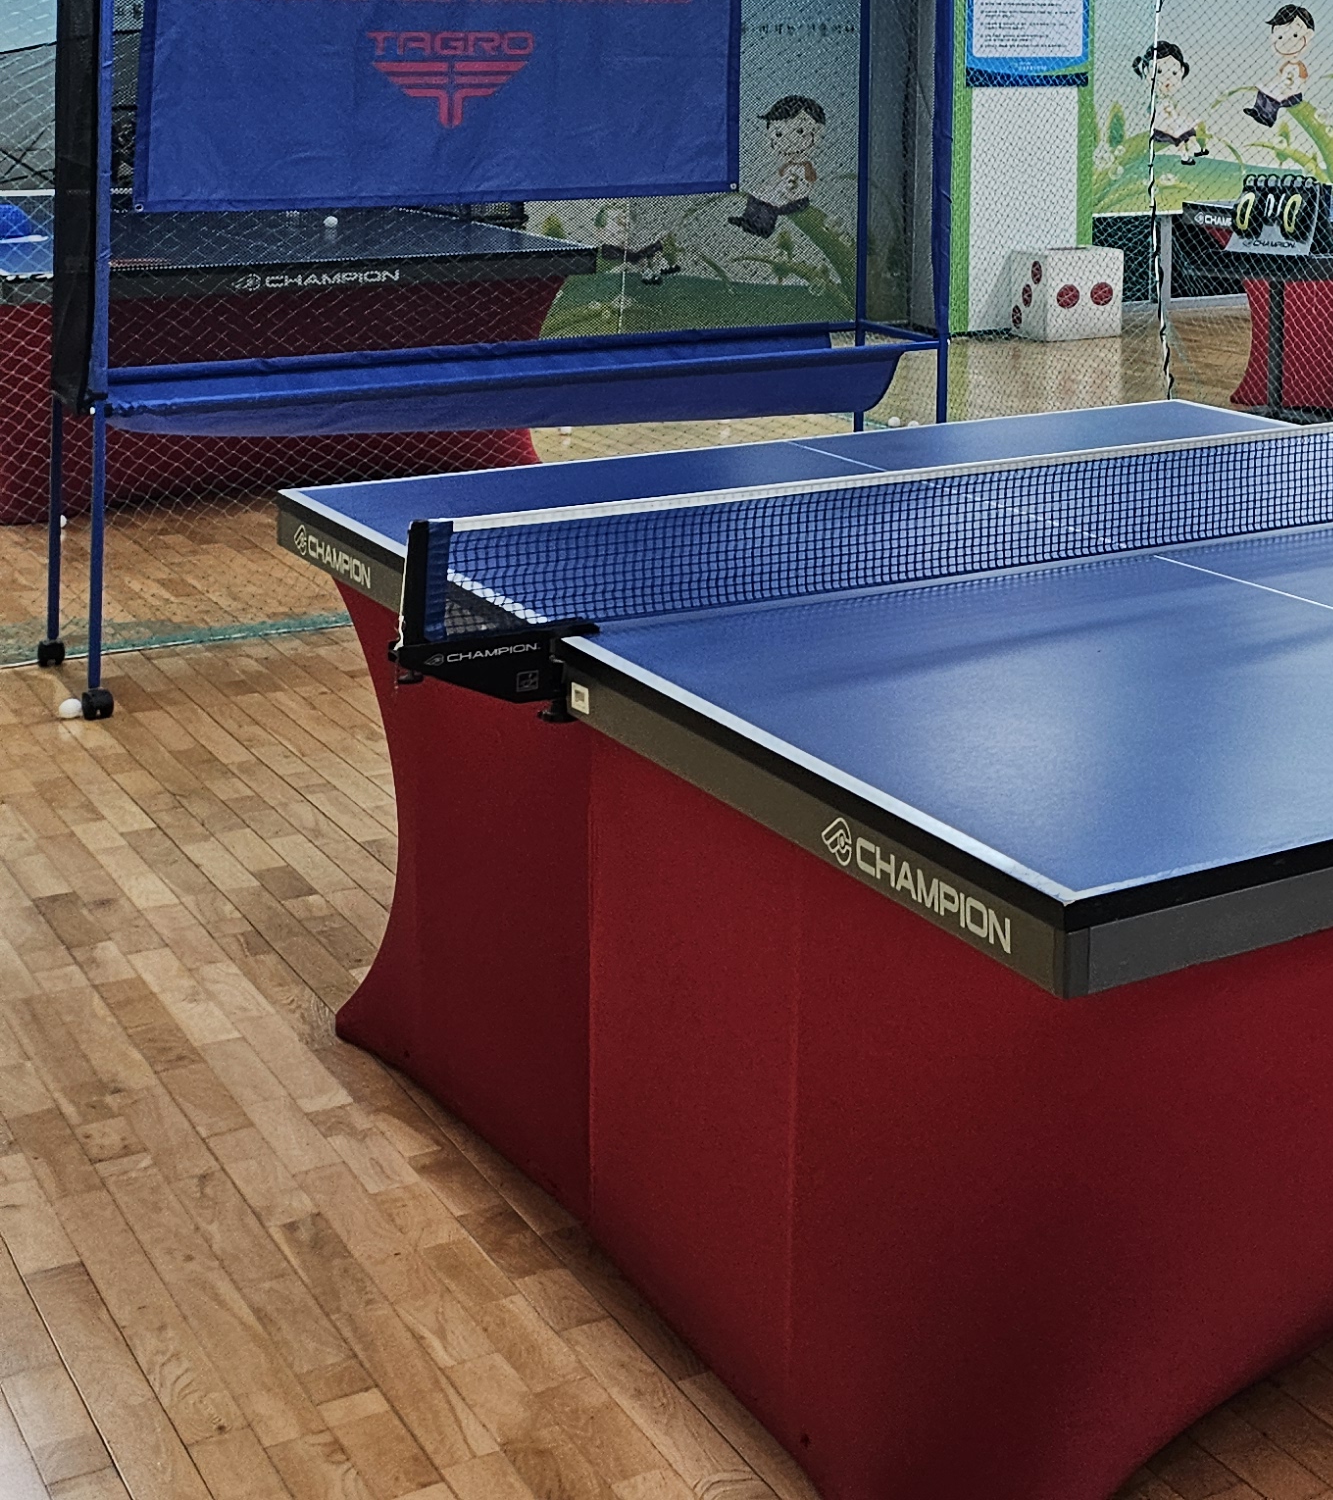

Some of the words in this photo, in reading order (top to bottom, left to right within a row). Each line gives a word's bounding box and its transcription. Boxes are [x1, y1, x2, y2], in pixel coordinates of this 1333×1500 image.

[366, 31, 534, 55] TAGRO
[1205, 214, 1232, 227] CHAMP
[265, 270, 400, 288] CHAMPION
[308, 534, 371, 589] CHAMPION
[446, 642, 538, 663] CHAMPION
[855, 836, 1012, 954] CHAMPION
